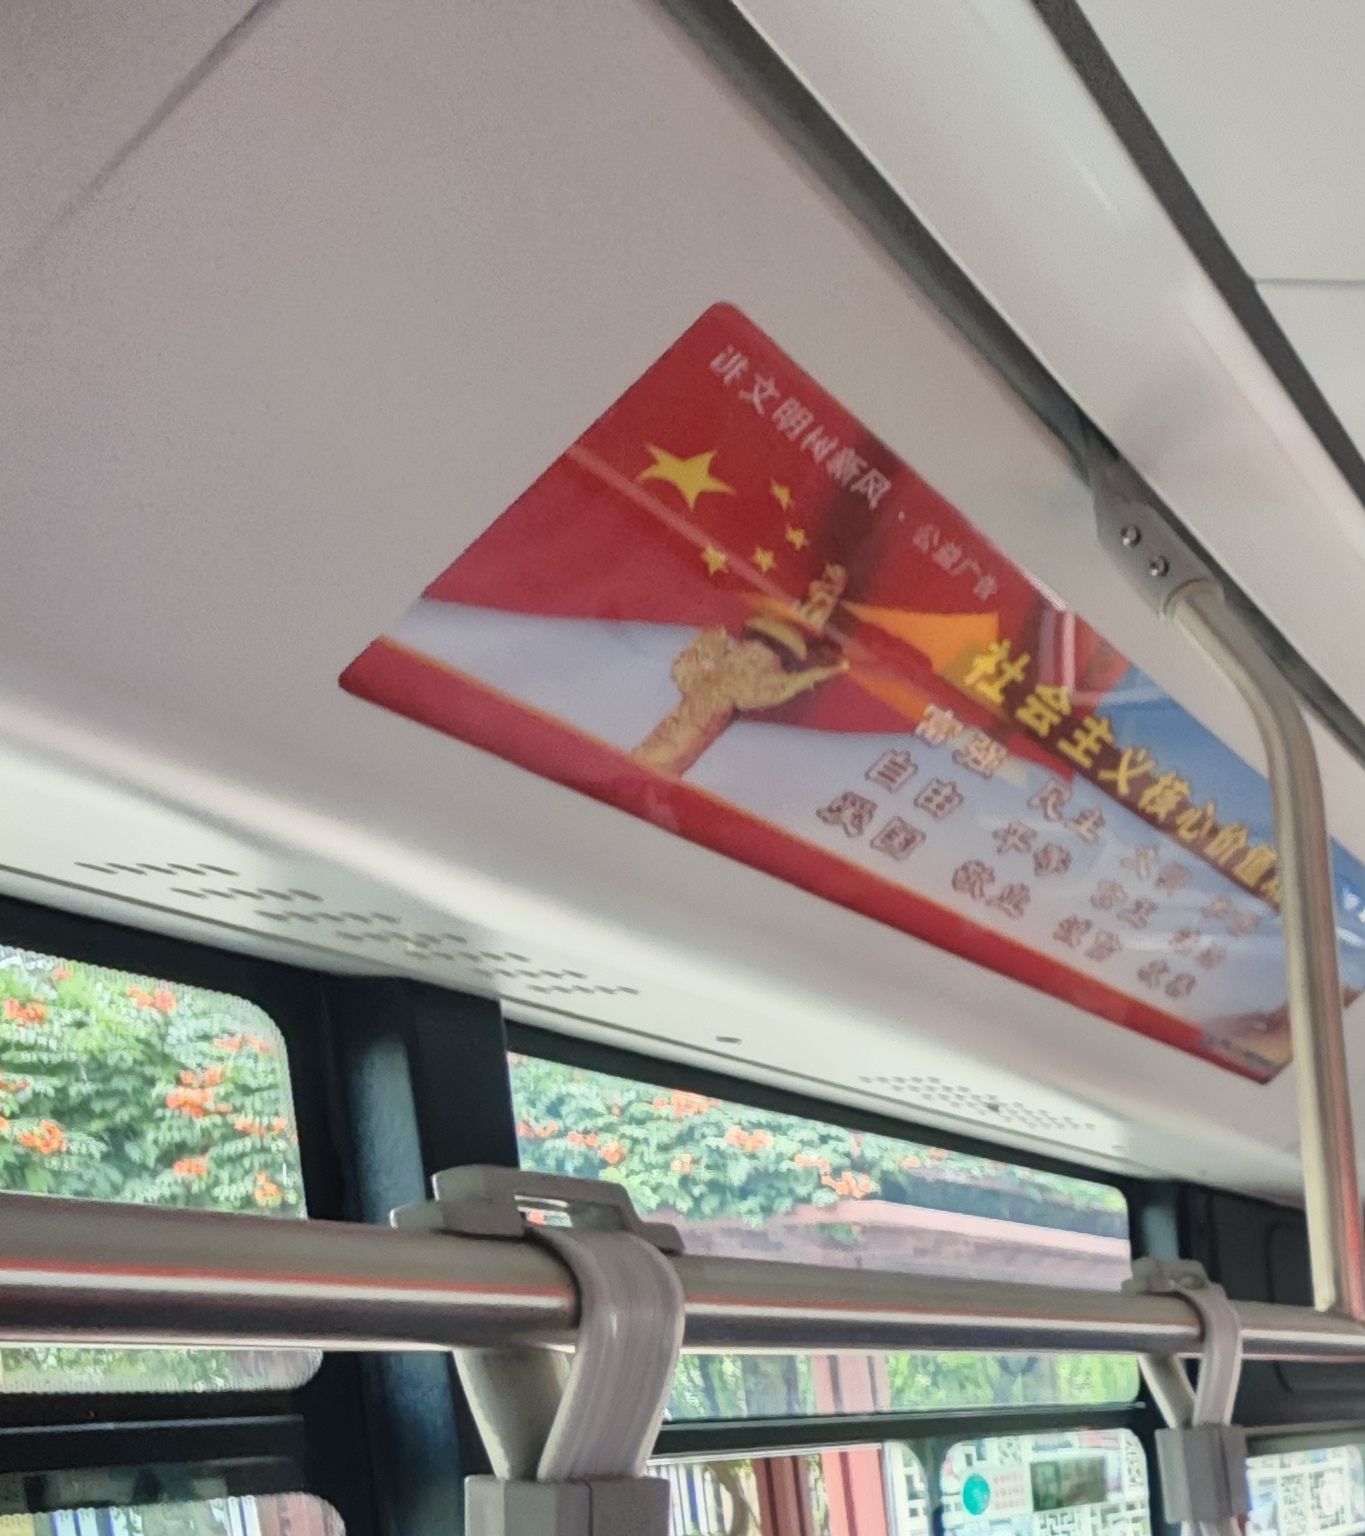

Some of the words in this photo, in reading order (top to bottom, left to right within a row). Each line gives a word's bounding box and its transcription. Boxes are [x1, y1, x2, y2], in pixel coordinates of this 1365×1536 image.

[864, 747, 964, 818] 自由
[992, 820, 1072, 877] 平等
[914, 702, 1009, 780] 富强
[1027, 778, 1106, 843] 民主
[816, 790, 926, 861] 爱国
[952, 859, 1031, 919] 敬业
[1052, 914, 1123, 963] 诚信
